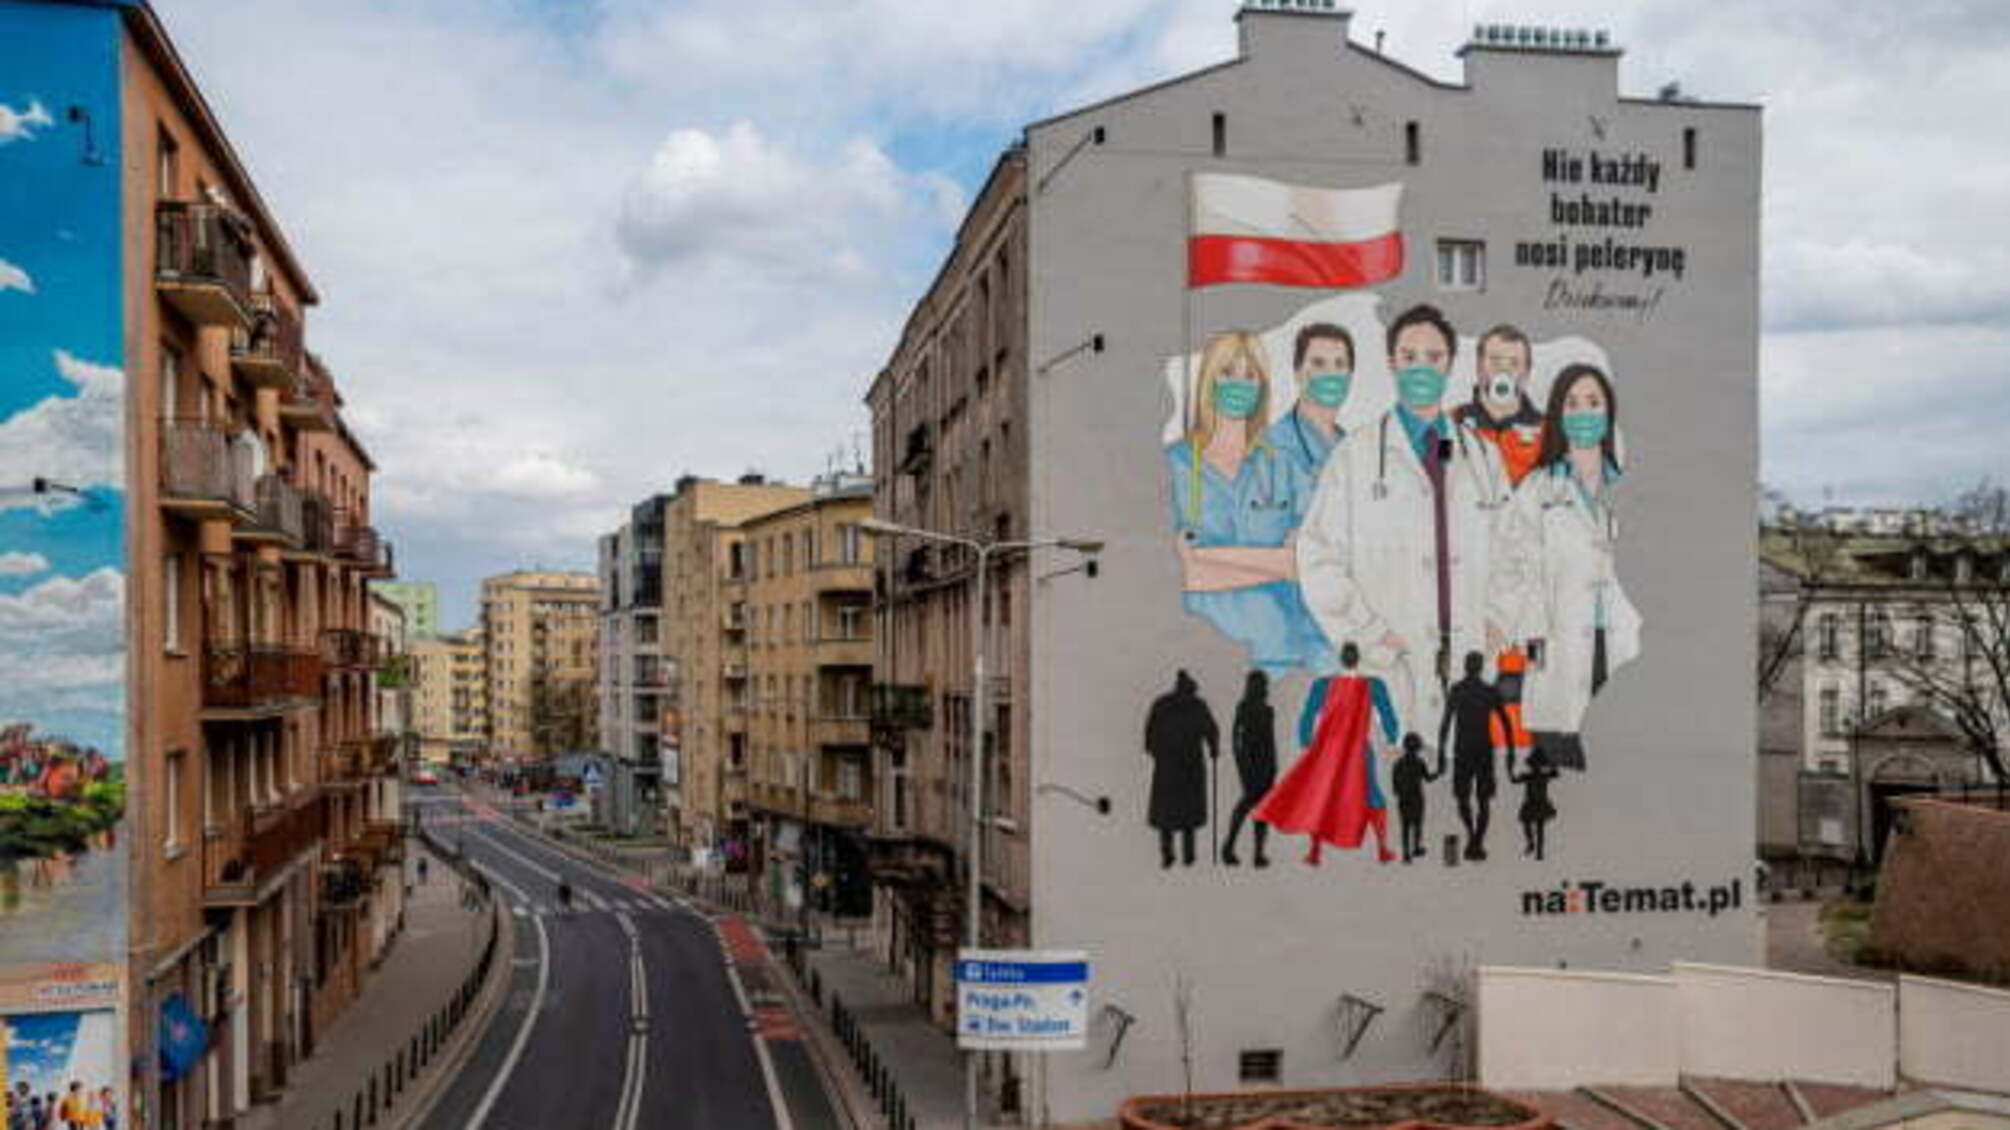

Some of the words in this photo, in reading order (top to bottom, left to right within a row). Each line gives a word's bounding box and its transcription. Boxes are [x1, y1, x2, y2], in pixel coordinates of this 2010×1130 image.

[1542, 149, 1583, 182] Nie
[1591, 151, 1660, 192] każdy
[1551, 193, 1652, 228] bohater
[1515, 234, 1567, 267] nosi
[1575, 237, 1685, 279] pelerynę
